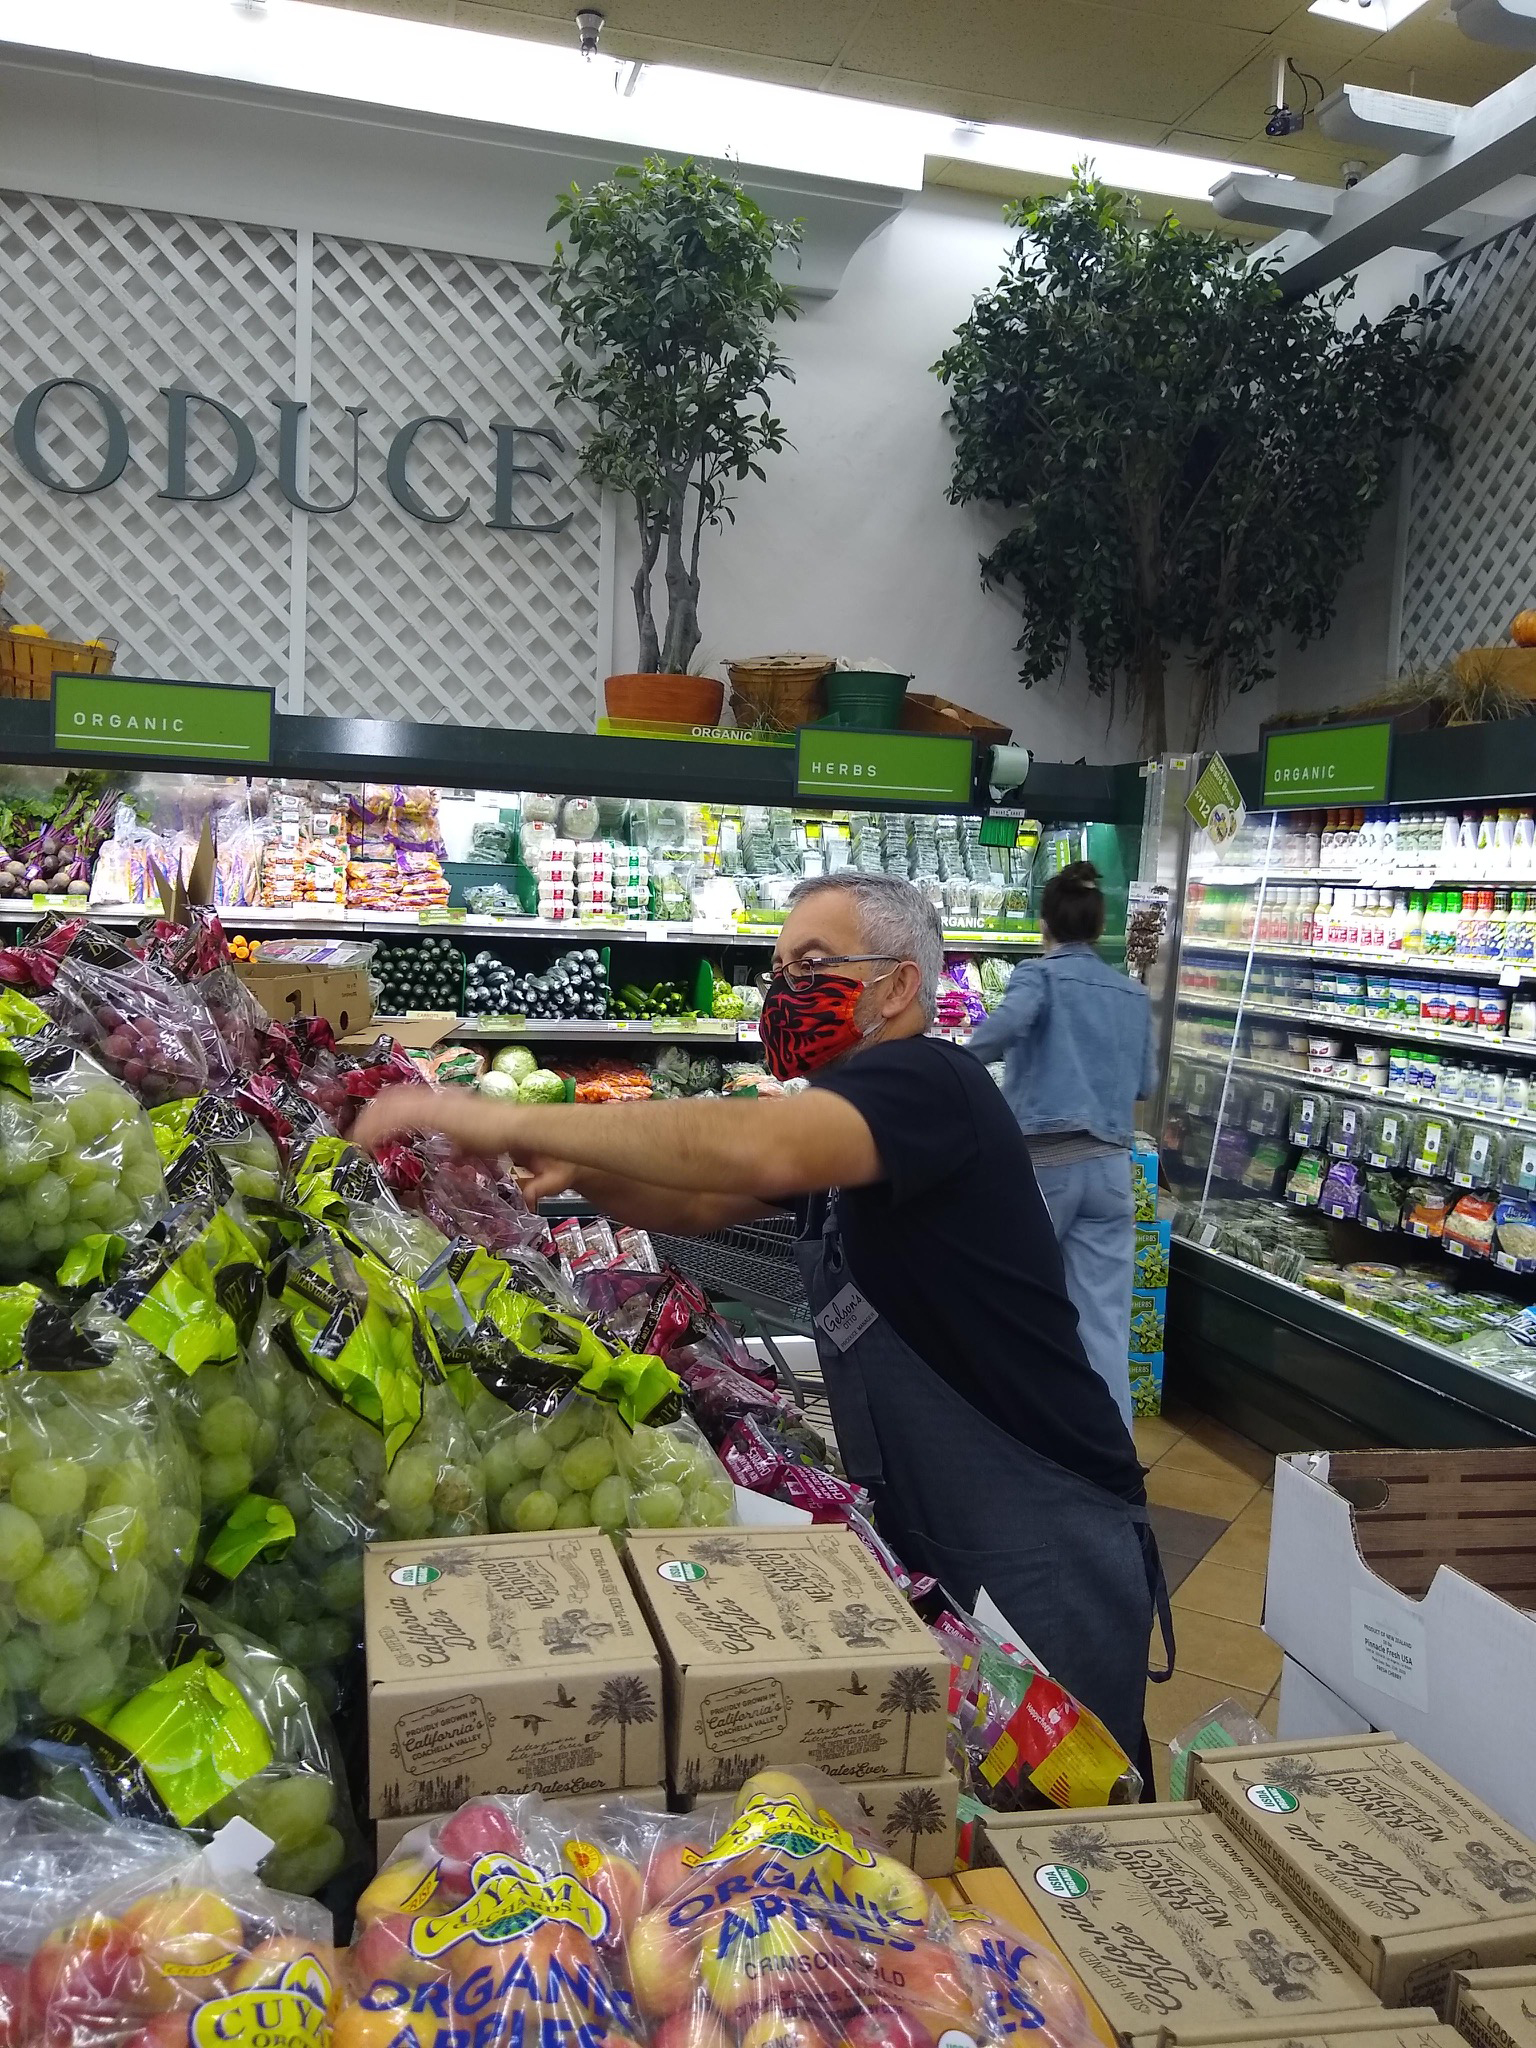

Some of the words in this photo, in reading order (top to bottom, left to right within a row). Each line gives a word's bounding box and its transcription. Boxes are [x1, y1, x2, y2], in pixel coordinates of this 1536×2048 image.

[13, 376, 575, 534] ODUCE
[72, 711, 186, 733] ORGANIC
[690, 725, 753, 743] ORGANIC
[811, 760, 879, 779] HERBS
[1273, 764, 1337, 783] ORGANIC
[1138, 1234, 1157, 1242] HERBS
[824, 1294, 862, 1333] Gelson's
[842, 1314, 858, 1330] OTTO
[1134, 1300, 1153, 1308] HERBS
[841, 1330, 859, 1348] PRODUCE
[856, 1312, 875, 1331] MANAGER
[1131, 1365, 1150, 1373] HERBS
[477, 1562, 525, 1601] RANCHO
[497, 1561, 555, 1610] MELADUCO
[746, 1552, 801, 1593] RANCHO
[765, 1552, 835, 1604] MELADUCO
[385, 1595, 450, 1668] California
[428, 1607, 478, 1651] Dates
[608, 1597, 635, 1637] HAND-PICKED
[672, 1583, 755, 1655] California
[716, 1596, 777, 1641] Dates
[884, 1593, 923, 1634] HAND-PICKED
[1364, 1637, 1386, 1654] Pinnacle
[1386, 1646, 1401, 1660] Fresh
[1401, 1654, 1413, 1666] USA
[1376, 1664, 1388, 1674] FRESH
[405, 1720, 440, 1738] PROUDLY
[440, 1712, 469, 1728] GROWN
[468, 1709, 478, 1721] IN
[705, 1700, 782, 1730] California's
[710, 1701, 741, 1717] PROUDLY
[741, 1695, 769, 1709] GROWN
[767, 1693, 778, 1703] IN
[402, 1717, 486, 1752] California's
[714, 1722, 754, 1739] COACHELLA
[753, 1714, 780, 1729] VALLEY
[412, 1742, 455, 1761] COACHELLA
[454, 1732, 482, 1748] VALLEY
[1256, 1789, 1276, 1809] USDA
[1268, 1786, 1291, 1811] ORGANIC
[1410, 1759, 1471, 1808] HAND-PACKED
[1323, 1778, 1405, 1830] RANCHO
[1343, 1776, 1450, 1843] MELADUCO
[1044, 1869, 1066, 1893] USDA
[1058, 1866, 1082, 1898] ORGANIC
[1113, 1851, 1193, 1912] RANCHO
[1211, 1832, 1266, 1894] HAND-PACKED
[1211, 1785, 1231, 1812] LOOK
[1229, 1806, 1240, 1821] AT
[1239, 1816, 1253, 1836] ALL
[1253, 1829, 1273, 1855] THAT
[1272, 1852, 1314, 1900] DELICIOUS
[1312, 1894, 1361, 1947] GOODNESS!
[1283, 1822, 1421, 1921] California
[1341, 1839, 1431, 1898] Dates
[668, 1861, 925, 1928] ORGANIC
[1133, 1849, 1233, 1929] MELADUCO
[453, 1901, 572, 1930] ORCHARDS
[1056, 1900, 1182, 2015] California
[1111, 1921, 1198, 1992] Dates
[1281, 1907, 1344, 1975] HAND-PICKED
[165, 1961, 223, 1976] CRISP
[744, 1951, 847, 1981] CRIMSON
